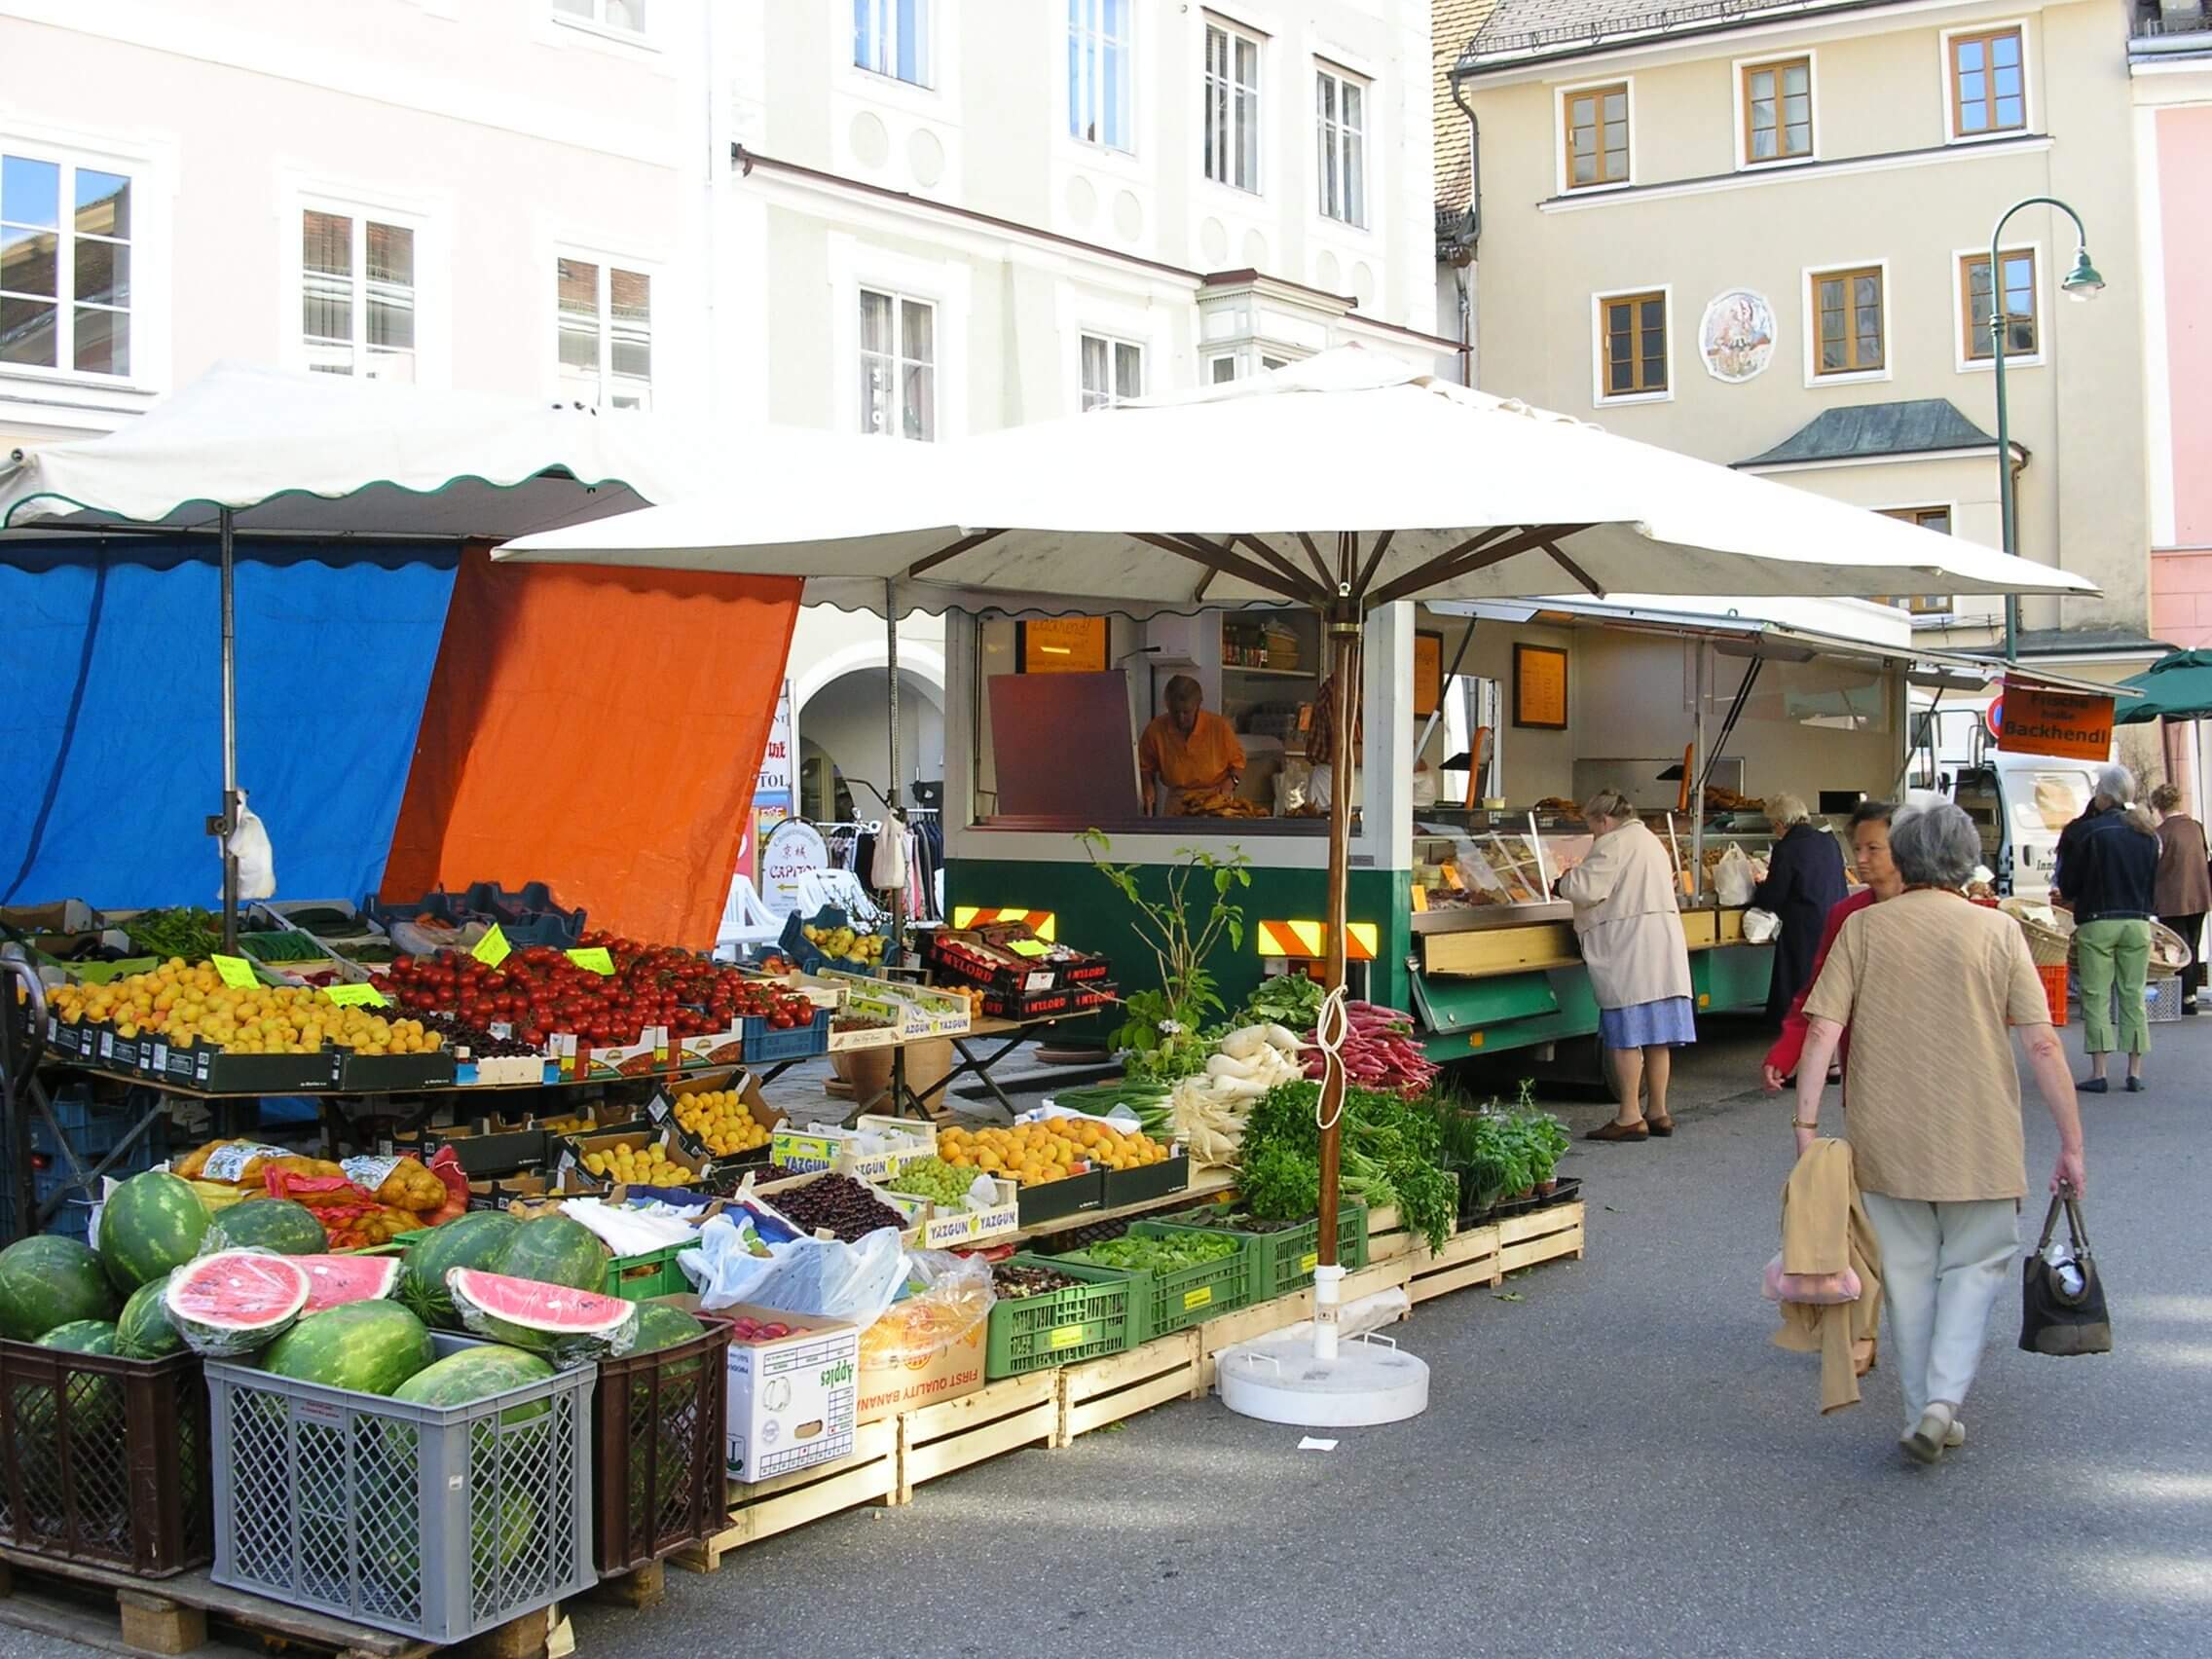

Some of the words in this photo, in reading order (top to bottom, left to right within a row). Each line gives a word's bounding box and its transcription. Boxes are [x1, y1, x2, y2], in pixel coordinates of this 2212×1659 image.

[2006, 721, 2107, 744] Backhendl
[1030, 996, 1067, 1013] MYLORD
[821, 1359, 855, 1388] Apples
[949, 1368, 978, 1387] FIRST
[903, 1378, 947, 1398] QUALITY
